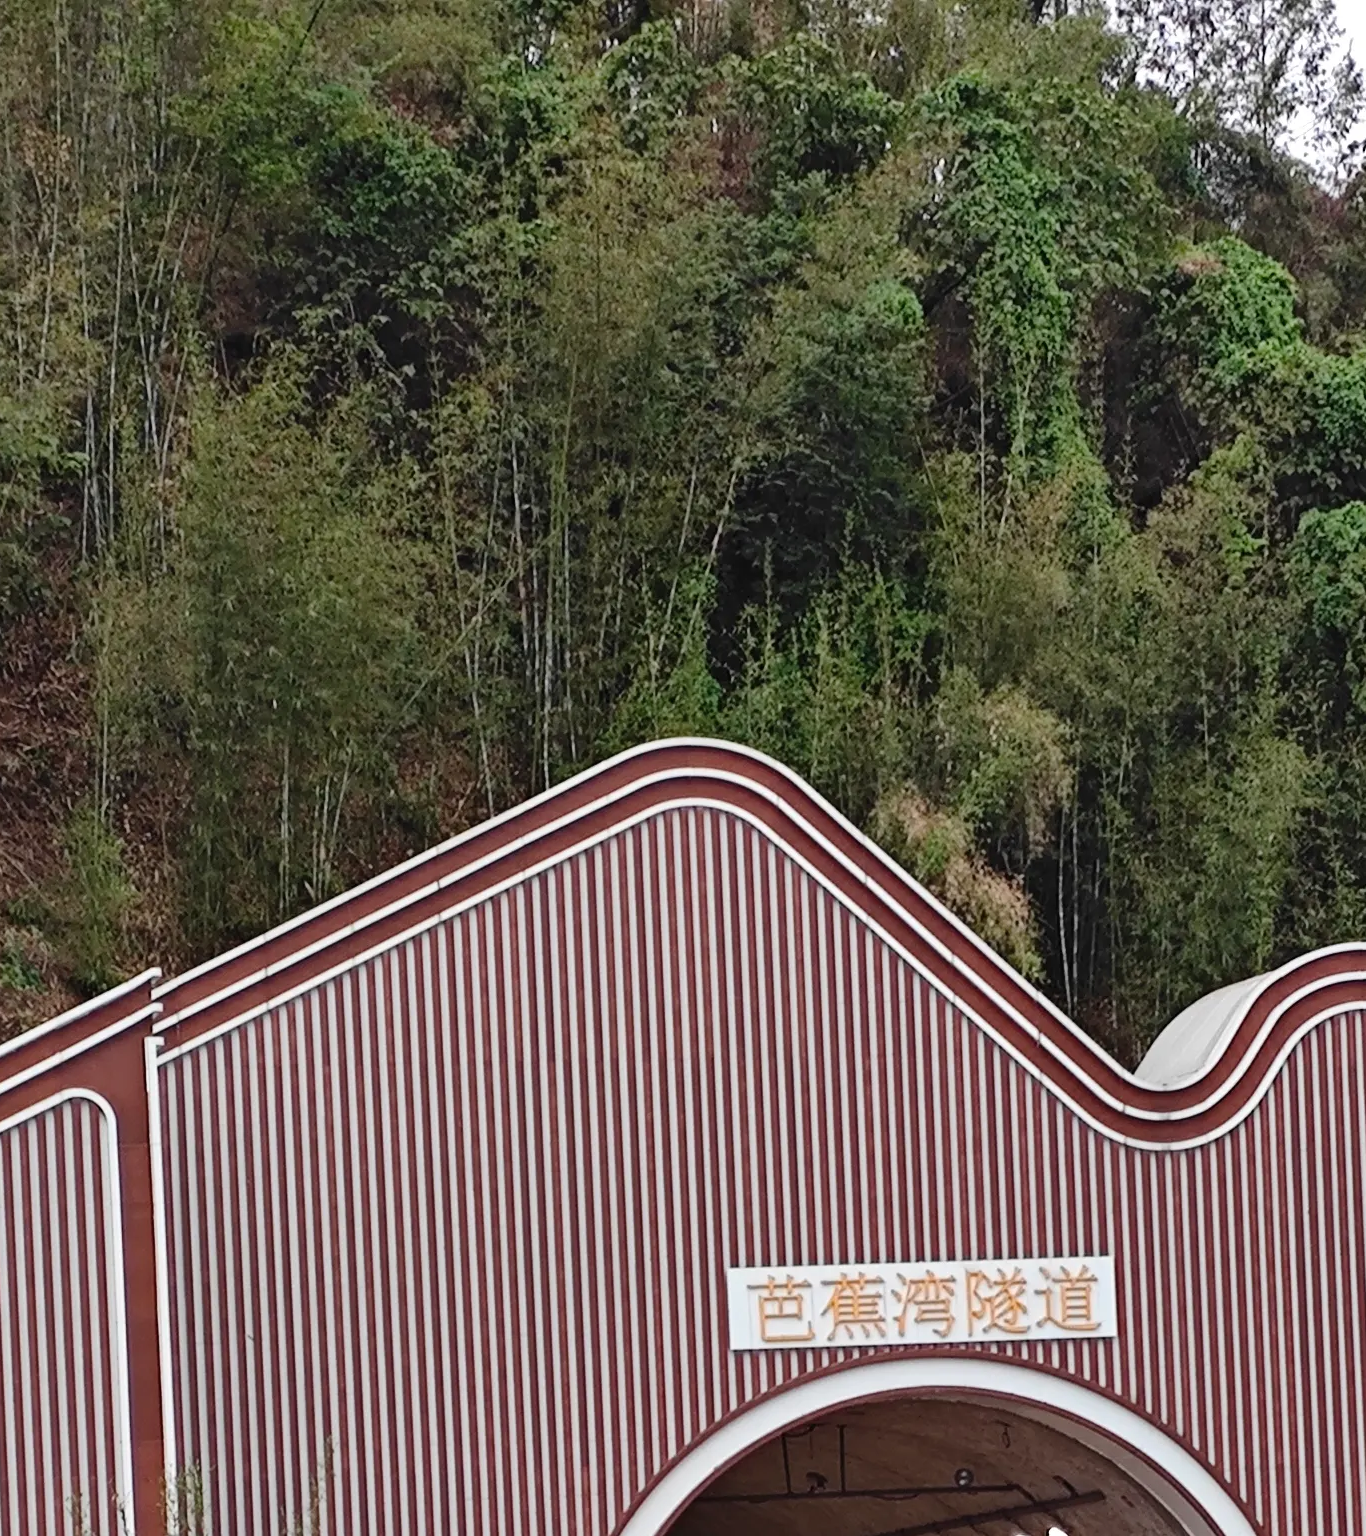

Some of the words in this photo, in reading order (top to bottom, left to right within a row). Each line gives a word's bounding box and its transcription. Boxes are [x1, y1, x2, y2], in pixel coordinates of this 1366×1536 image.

[747, 1265, 1101, 1342] 芭蕉湾隧道
